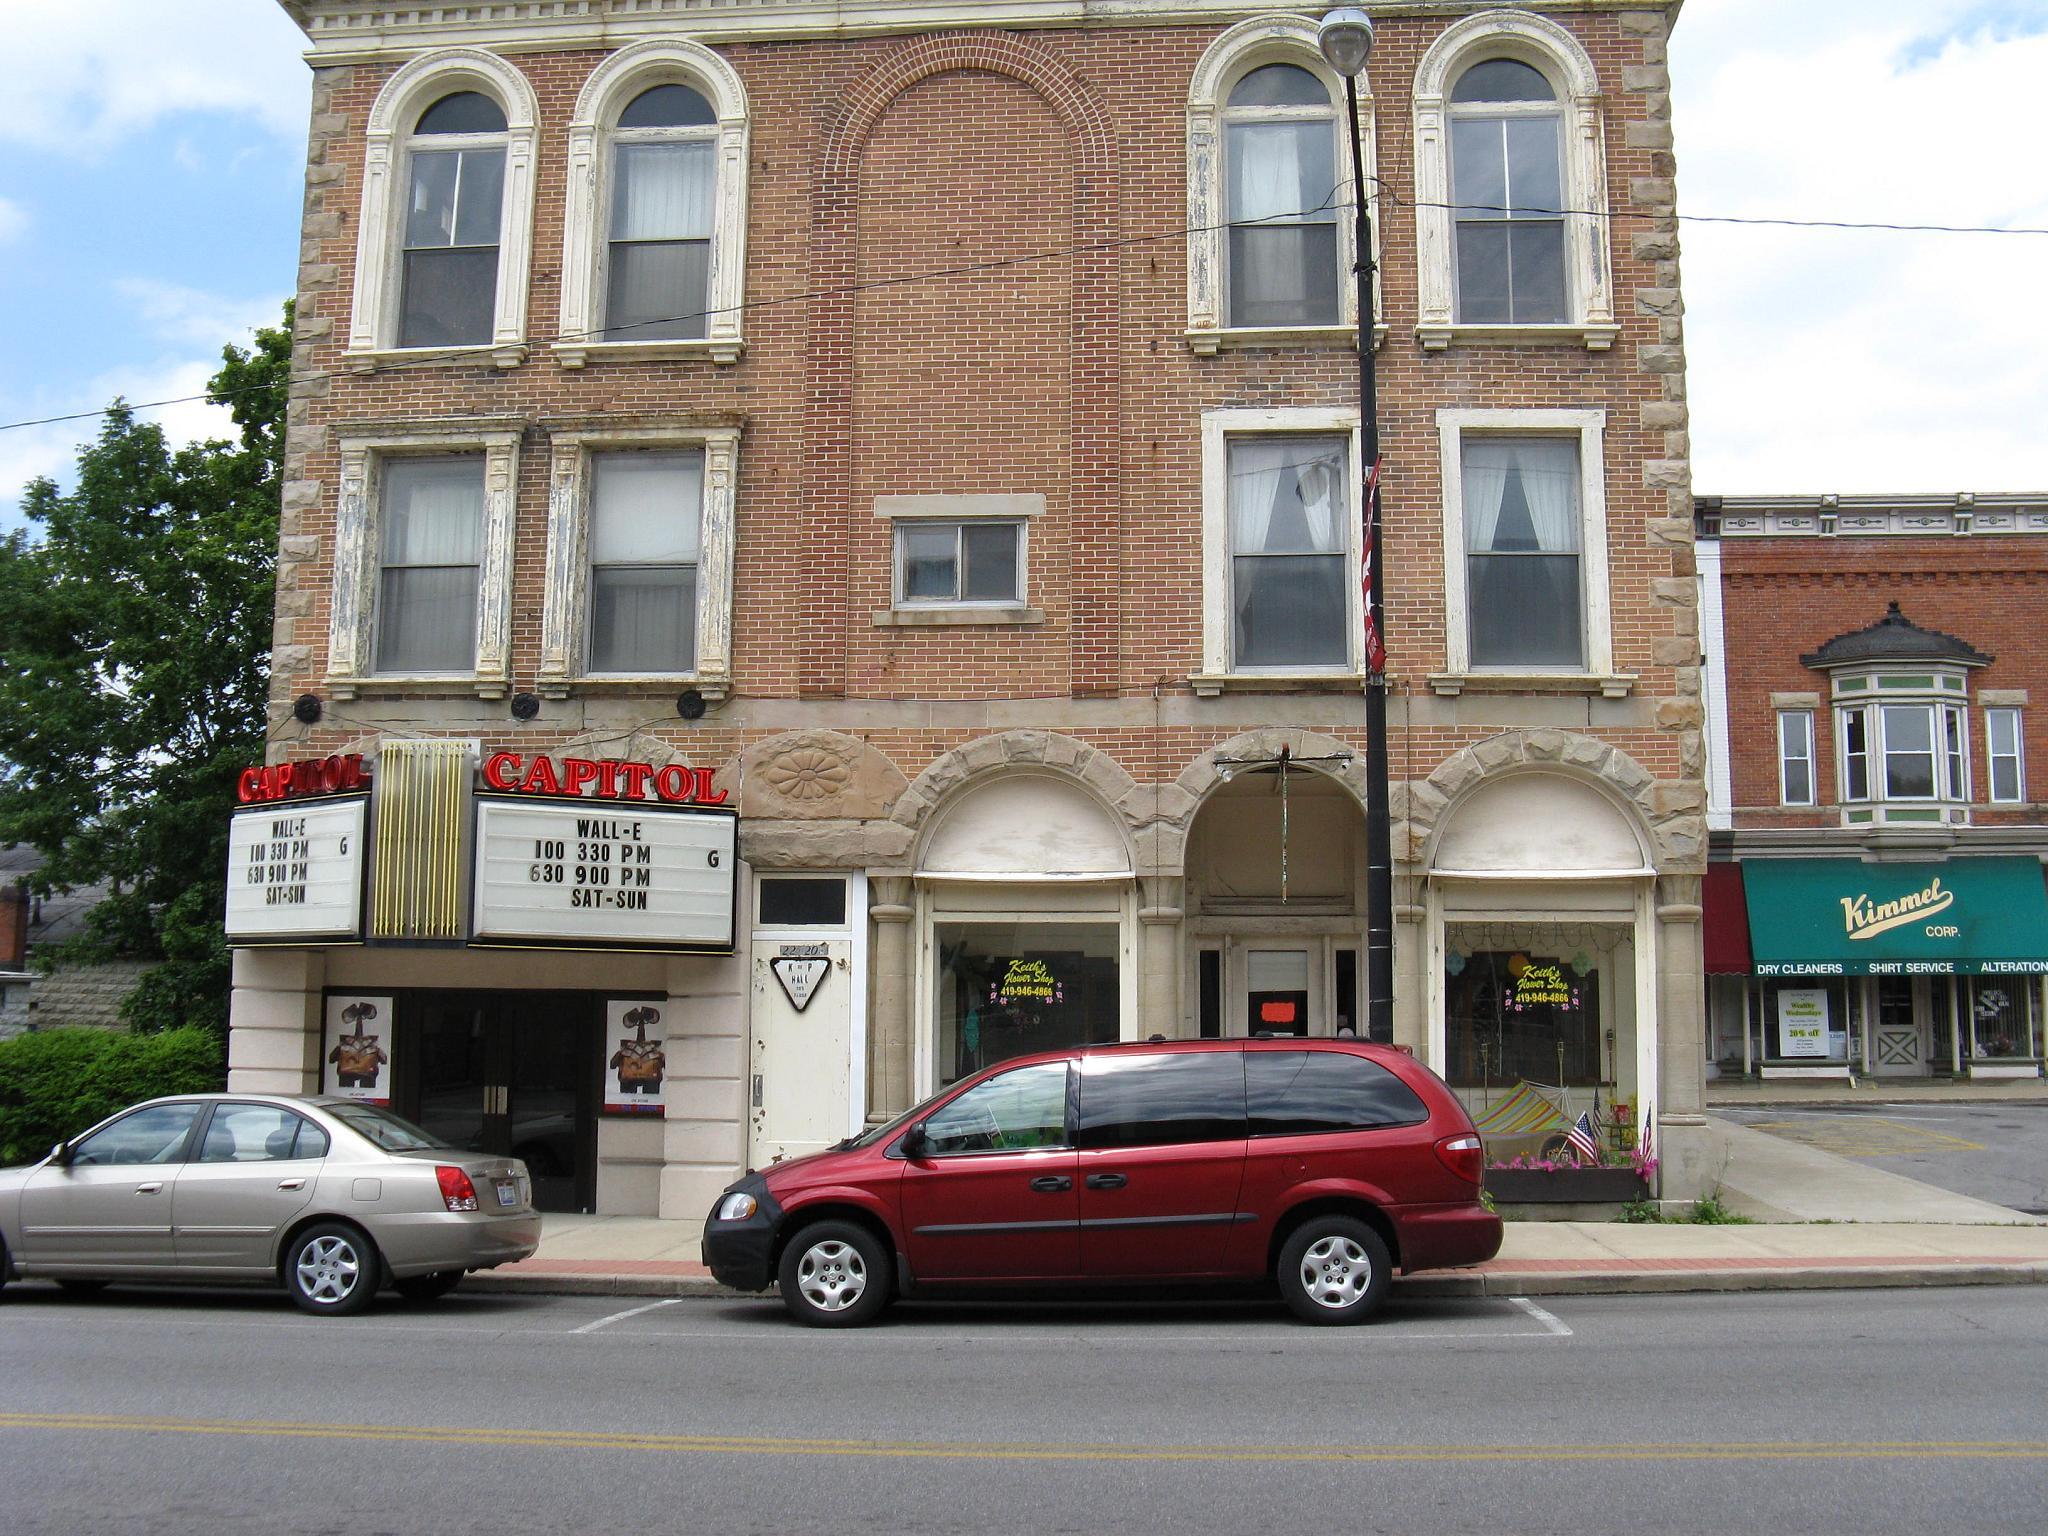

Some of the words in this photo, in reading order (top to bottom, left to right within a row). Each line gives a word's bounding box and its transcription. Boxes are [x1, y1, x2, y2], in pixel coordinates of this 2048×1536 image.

[238, 754, 372, 802] CAPITOL
[484, 752, 728, 804] CAPITOL
[272, 818, 305, 838] WALL-E
[577, 819, 641, 841] WALL-E
[250, 843, 266, 863] 100
[270, 841, 288, 861] 330
[292, 840, 309, 860] PM
[339, 836, 348, 856] G
[535, 840, 565, 860] 100
[577, 843, 610, 862] 330
[621, 844, 651, 864] PM
[707, 850, 720, 868] G
[247, 866, 265, 884] 630
[268, 863, 287, 883] 900
[291, 862, 307, 881] PM
[529, 864, 564, 883] 630
[575, 865, 610, 885] 900
[621, 867, 650, 887] PM
[266, 885, 306, 905] SAT-SUN
[571, 889, 648, 910] SAT-SUN
[1840, 877, 1953, 938] Kimmel
[1925, 926, 1961, 937] CORP.
[1009, 960, 1047, 973] Keith's
[1522, 965, 1560, 979] Keith's
[1757, 964, 1780, 974] DRY
[1782, 963, 1843, 974] CLEANERS
[1868, 963, 1903, 973] SHIRT
[1905, 962, 1954, 973] SERVICE
[1004, 973, 1031, 986] Flower
[1033, 971, 1055, 986] Shop
[1516, 978, 1545, 992] Flower
[1546, 976, 1569, 992] Shop
[1516, 992, 1569, 1003] 419-946-4866
[1789, 1029, 1806, 1037] 20%
